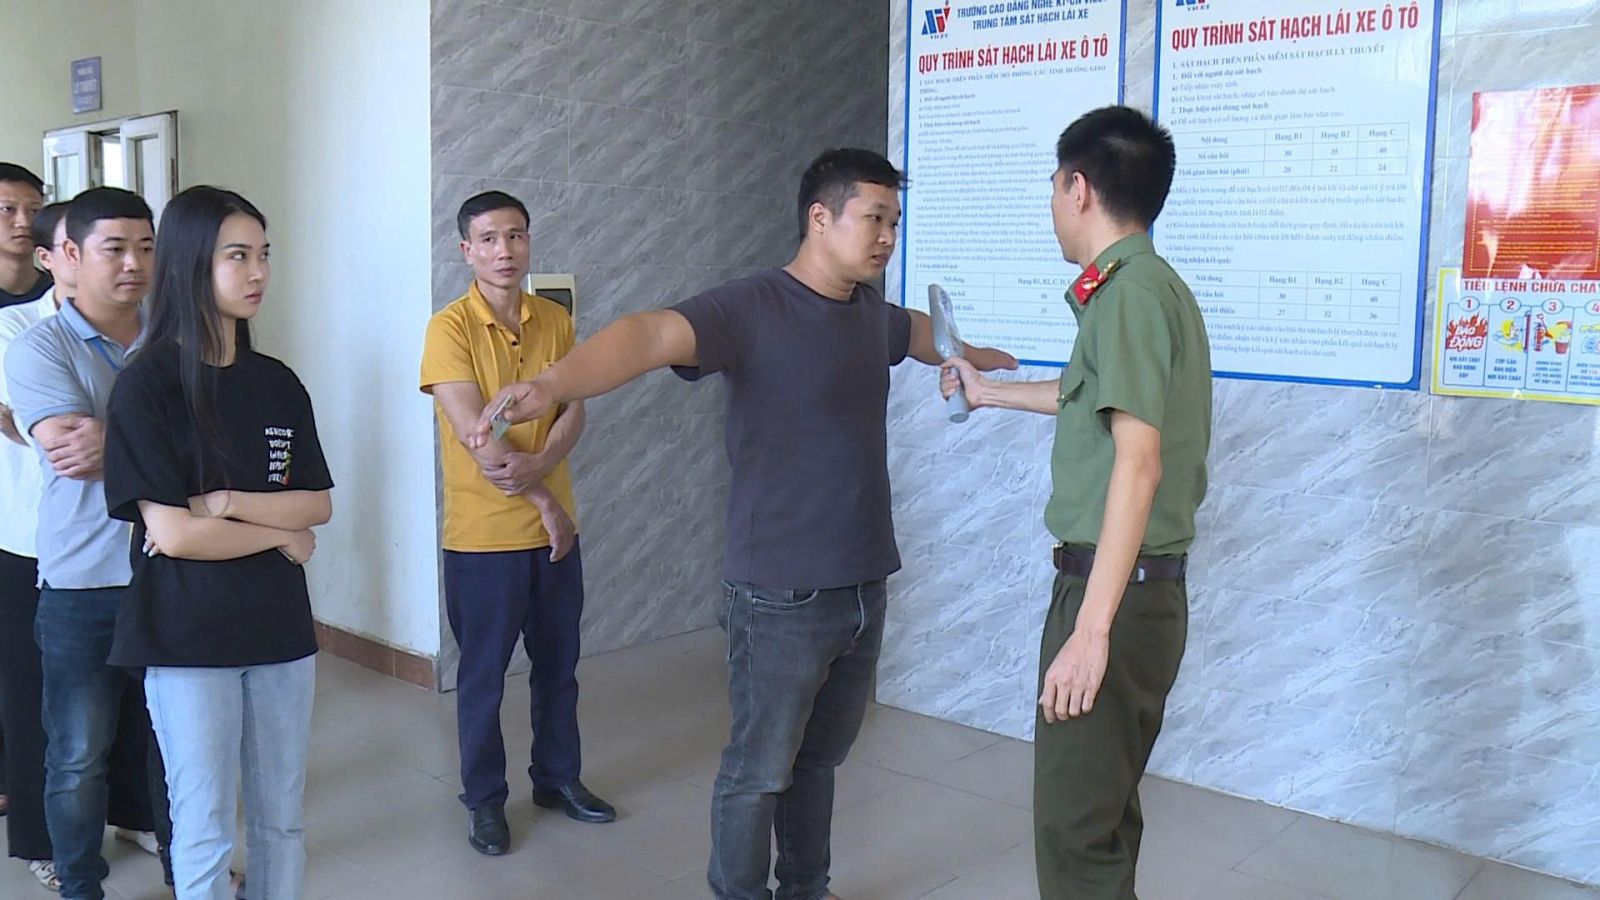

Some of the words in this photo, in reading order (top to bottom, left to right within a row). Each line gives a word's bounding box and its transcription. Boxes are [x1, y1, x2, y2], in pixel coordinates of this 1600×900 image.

[990, 4, 1005, 15] CAO
[972, 18, 998, 30] TRUNG
[1000, 15, 1017, 27] TÂM
[1020, 12, 1035, 25] SÁT
[1037, 11, 1060, 26] HẠCH
[1062, 8, 1075, 21] LÁI
[1078, 8, 1089, 19] XE
[1172, 28, 1198, 51] QUY
[1202, 20, 1244, 46] TRÌNH
[1248, 16, 1276, 42] SÁT
[1280, 14, 1322, 43] HẠCH
[1326, 8, 1351, 35] LÁI
[1356, 10, 1376, 33] XE
[1382, 4, 1393, 30] Ô
[1398, 2, 1419, 29] TÔ
[918, 54, 939, 74] QUY
[942, 48, 974, 71] TRÌNH
[978, 44, 999, 67] SÁT
[1002, 44, 1034, 68] HẠCH
[1038, 38, 1056, 62] LÁI
[1060, 40, 1076, 60] XE
[1081, 35, 1089, 58] Ô
[1093, 33, 1108, 57] TÔ
[1221, 56, 1241, 65] TRÊN
[1466, 300, 1471, 309] 1
[1507, 300, 1515, 310] 2
[1549, 302, 1557, 312] 3
